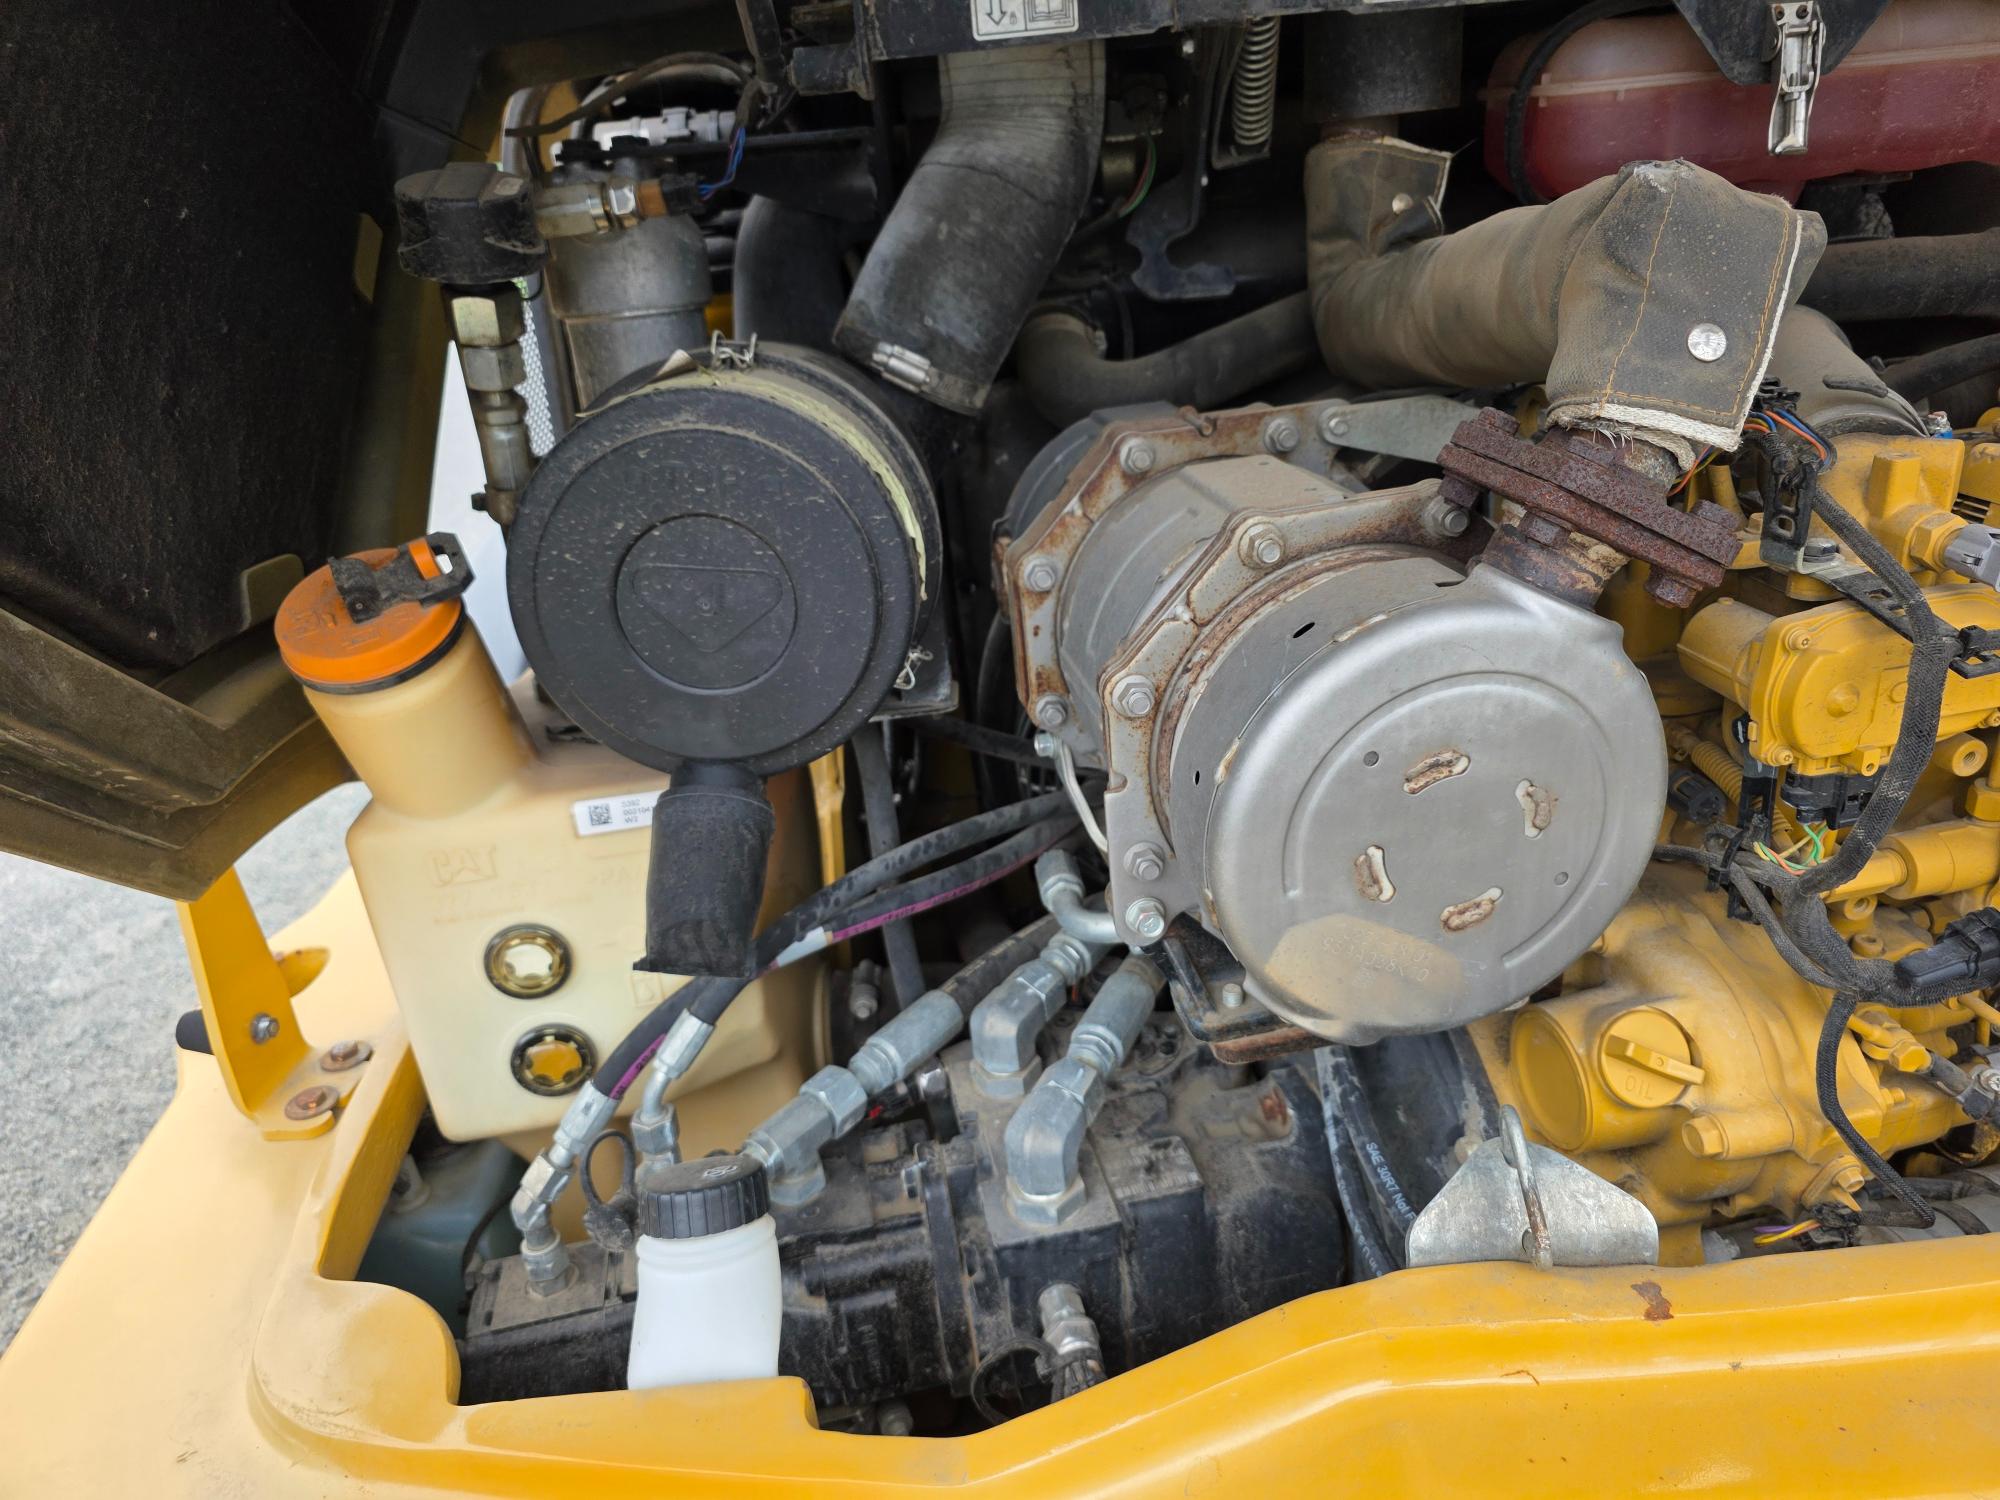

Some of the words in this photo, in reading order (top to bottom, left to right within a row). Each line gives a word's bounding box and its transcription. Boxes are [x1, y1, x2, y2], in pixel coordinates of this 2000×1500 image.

[1625, 1074, 1654, 1101] OIL
[1366, 1142, 1385, 1166] SAE
[1377, 1165, 1400, 1193] 30R7
